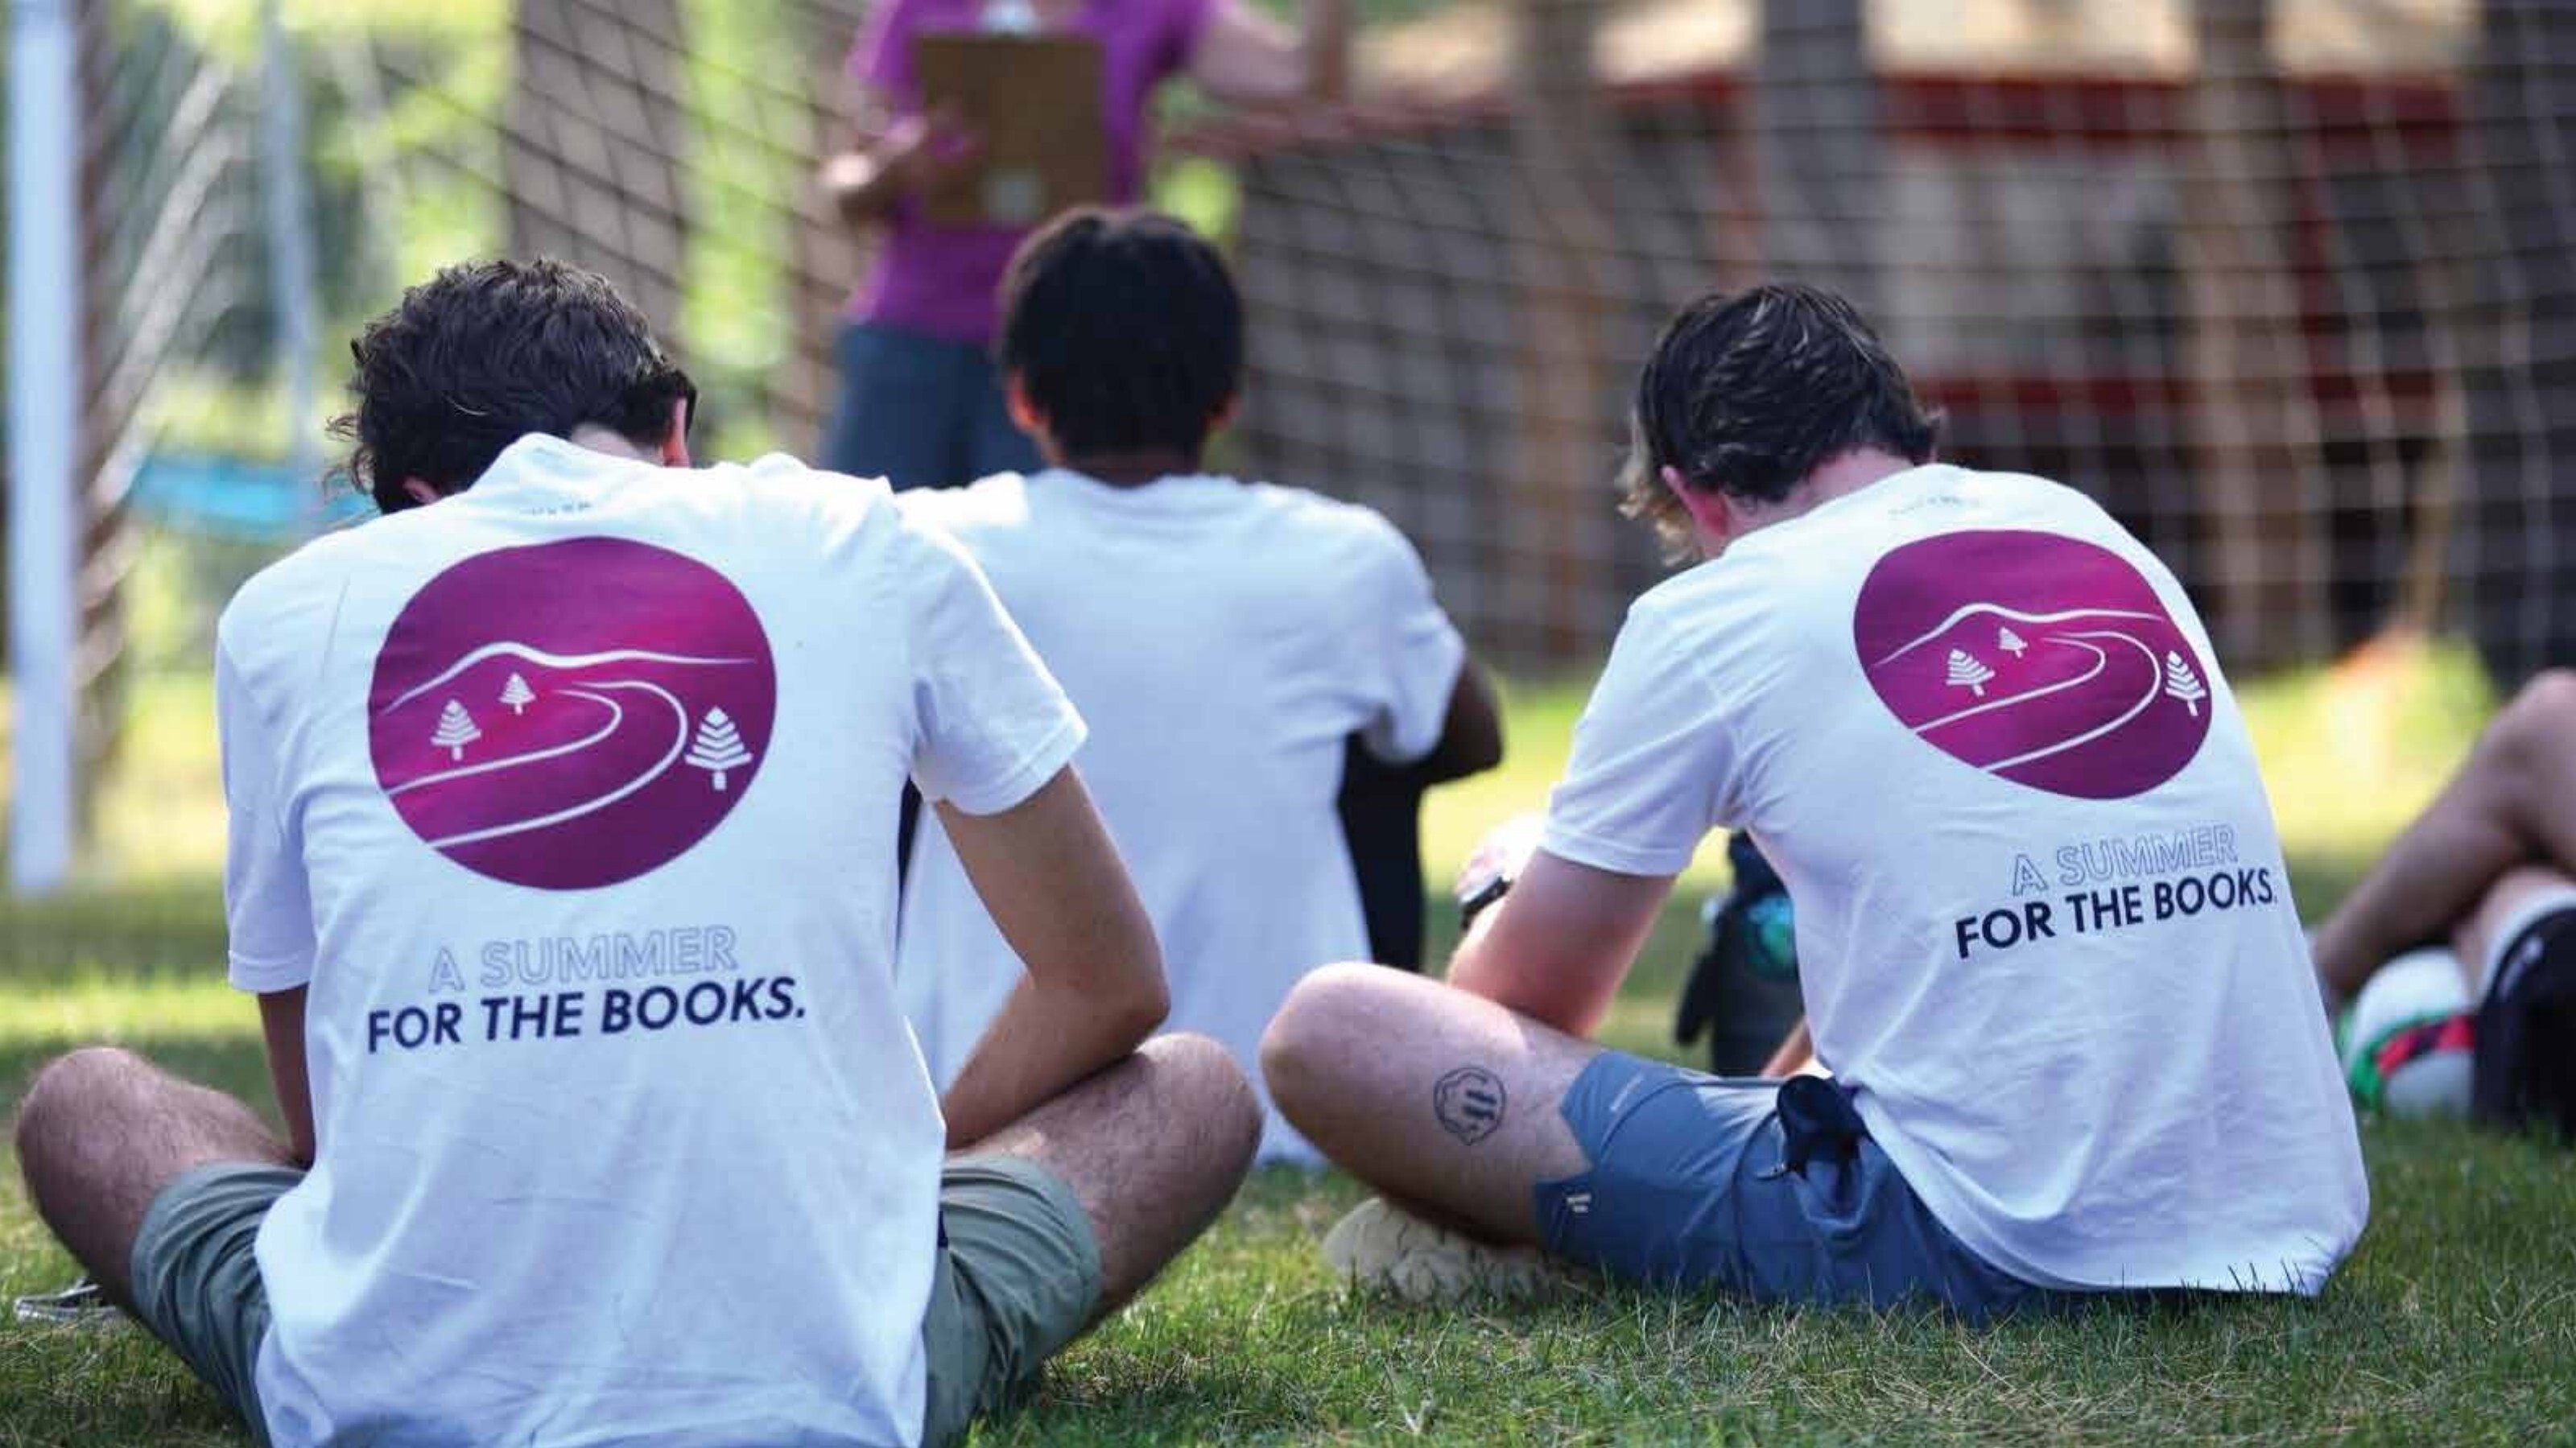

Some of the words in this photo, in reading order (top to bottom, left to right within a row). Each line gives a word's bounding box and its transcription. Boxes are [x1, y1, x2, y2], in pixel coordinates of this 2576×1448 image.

[2013, 854, 2047, 895] A
[2057, 824, 2238, 885] SUMMER
[1955, 901, 2056, 959] FOR
[2065, 885, 2143, 932] THE
[428, 947, 465, 993] A
[481, 925, 738, 988] SUMMER
[368, 1003, 461, 1053] FOR
[481, 991, 584, 1040] THE
[601, 976, 805, 1033] BOOKS.
